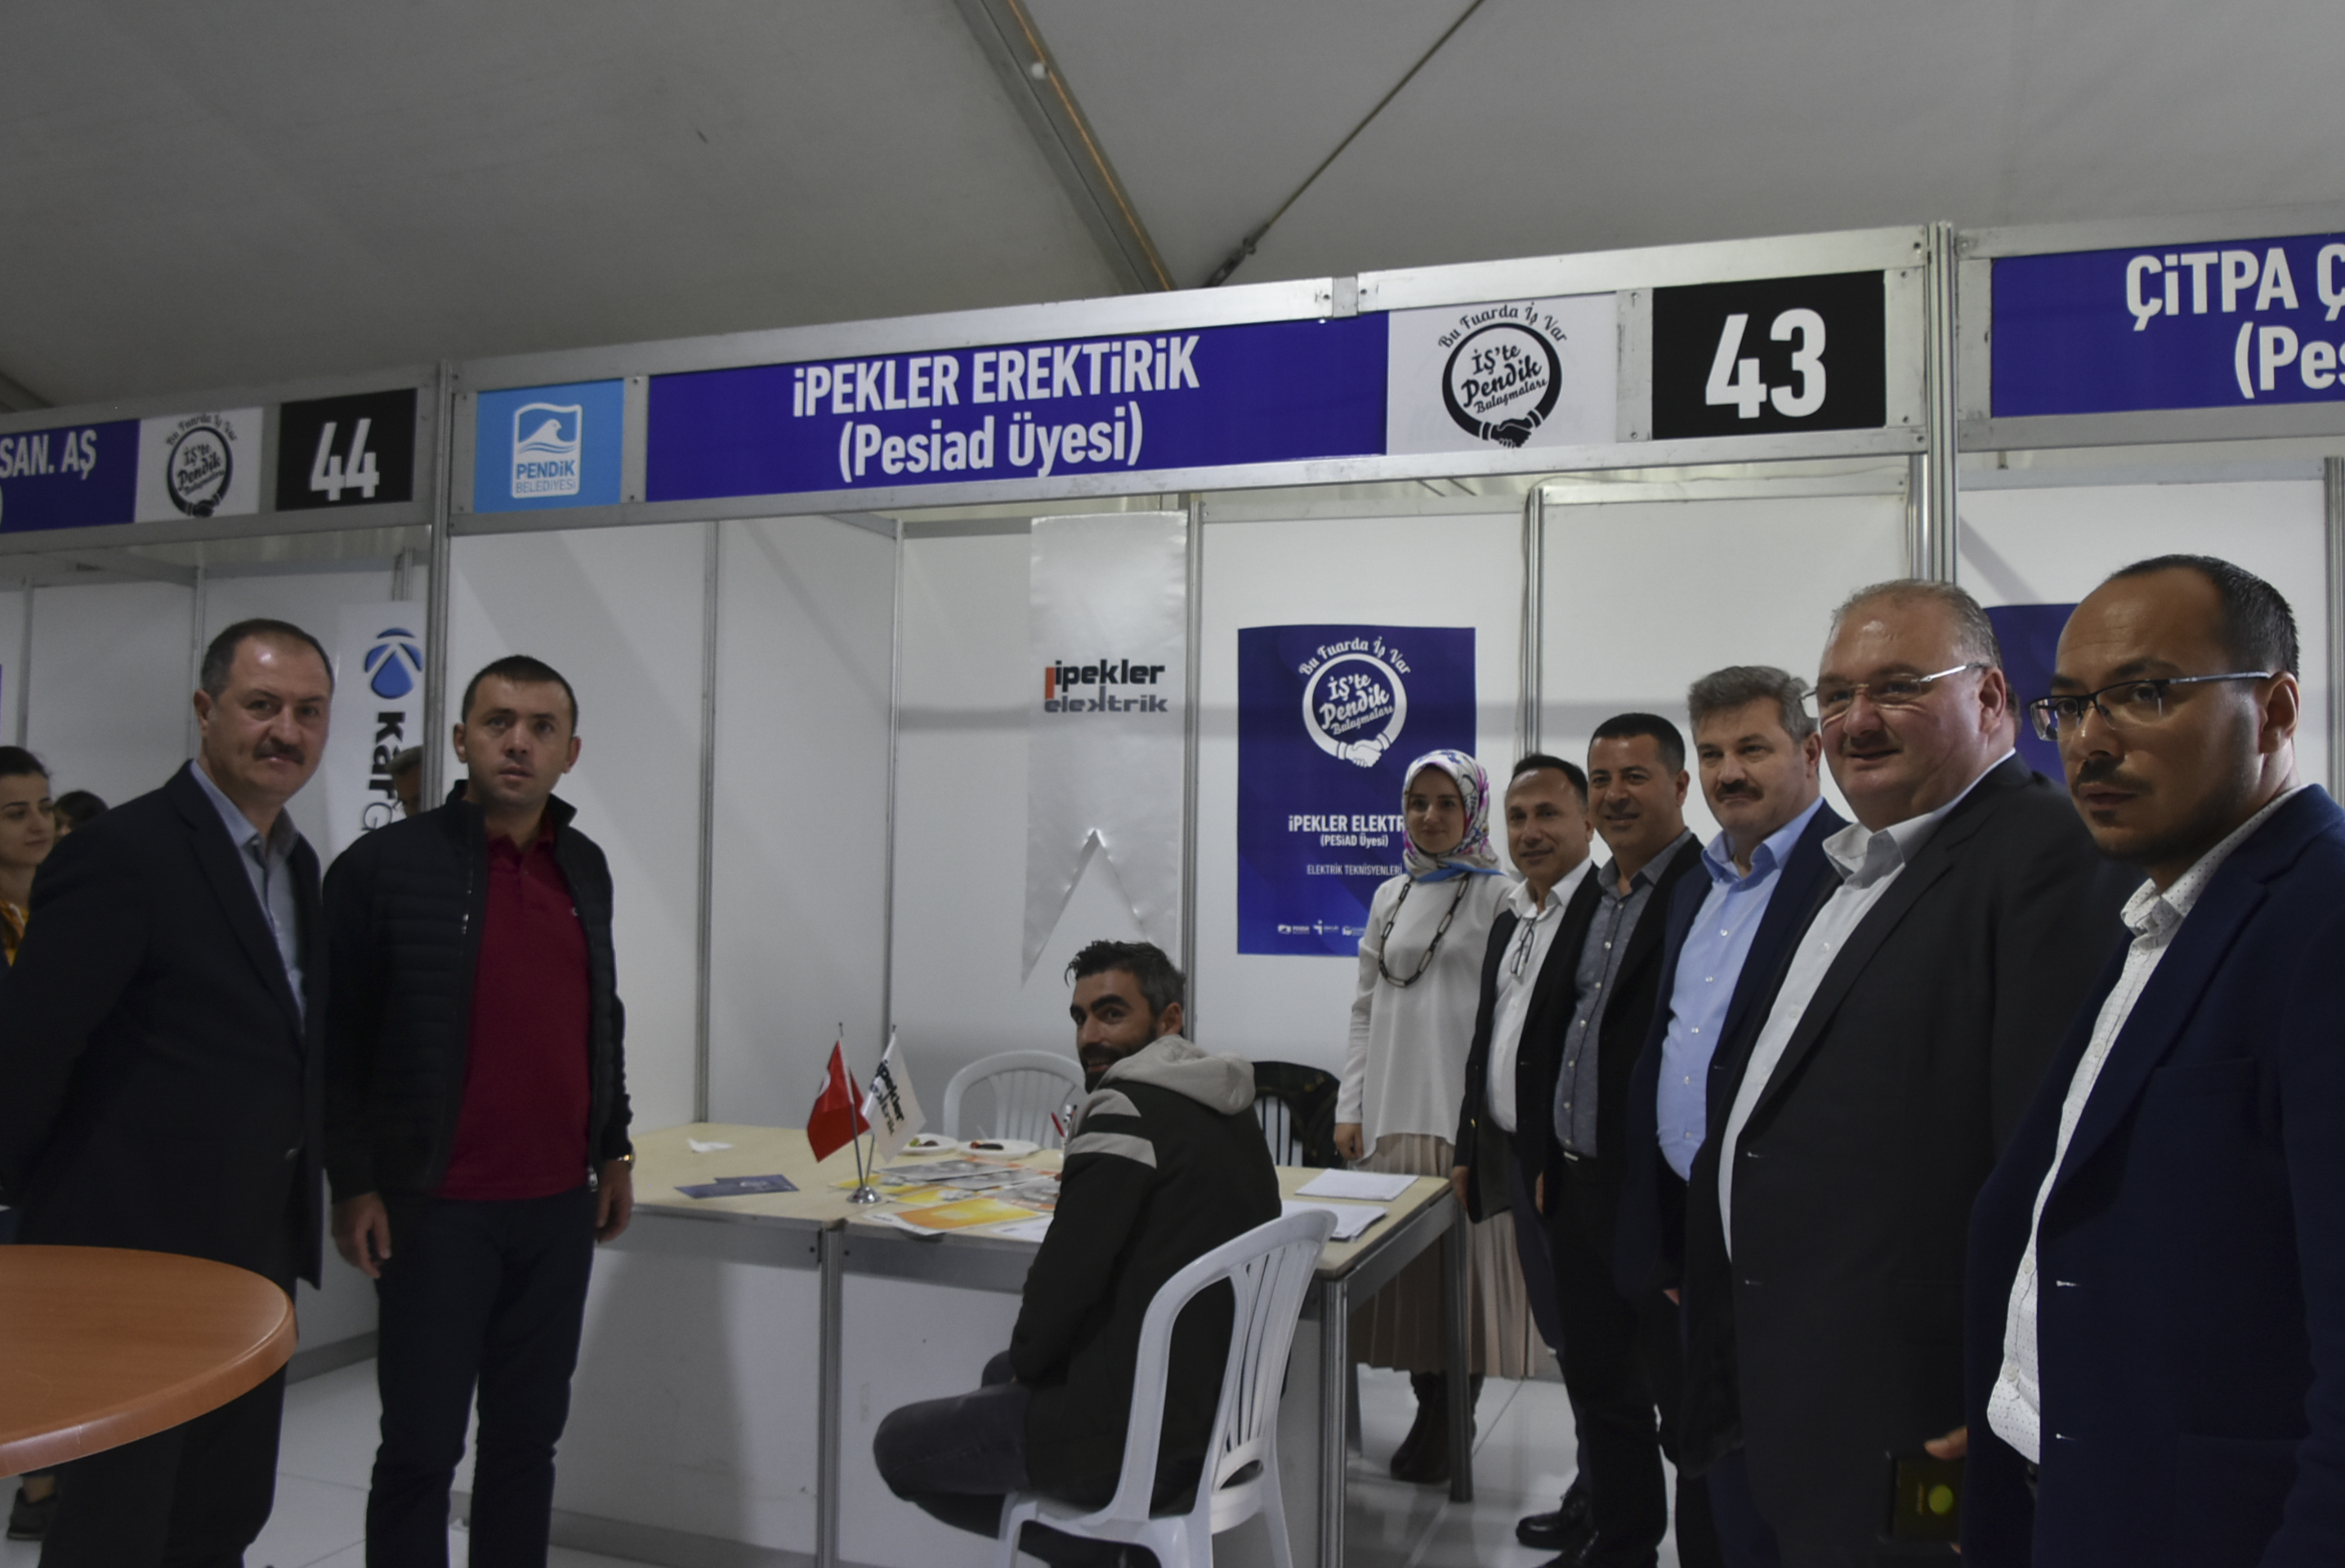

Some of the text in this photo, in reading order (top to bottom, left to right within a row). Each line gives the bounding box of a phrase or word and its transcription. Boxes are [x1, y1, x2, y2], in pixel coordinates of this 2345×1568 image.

[1438, 328, 1462, 349] Bu
[1459, 305, 1519, 330] Fuarda
[1543, 315, 1567, 342] Var
[1461, 354, 1543, 409] Pendik
[1705, 308, 1826, 418] 43
[0, 429, 97, 480] SAN. AŞ
[310, 417, 381, 502] 44
[839, 400, 1142, 482] (Pesiad Üyesi)
[1055, 659, 1166, 693] ipekler
[1298, 657, 1320, 676] Bu
[1316, 637, 1369, 660] Fuarda
[1391, 648, 1411, 674] Var
[1319, 683, 1390, 730] Pendik
[1351, 815, 1404, 833] ELEKTR
[1359, 832, 1389, 849] Üyesi)
